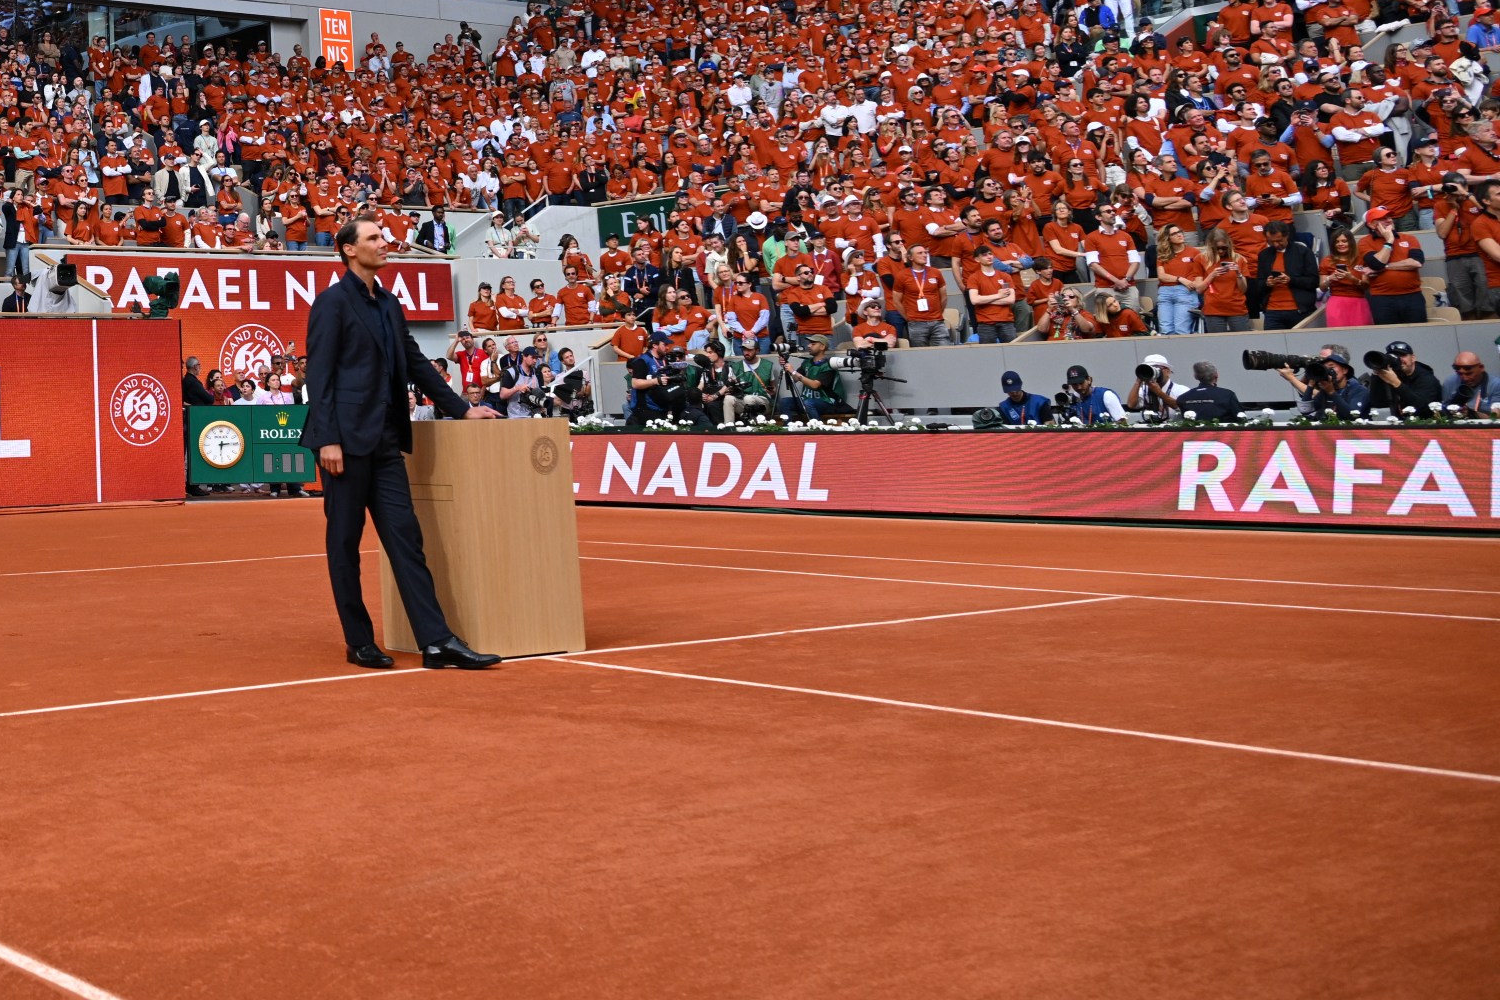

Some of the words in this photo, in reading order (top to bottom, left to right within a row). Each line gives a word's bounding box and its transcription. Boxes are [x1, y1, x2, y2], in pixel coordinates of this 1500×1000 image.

[324, 18, 347, 35] TEN
[327, 45, 349, 63] NIS
[85, 265, 270, 310] RAAEL
[285, 270, 439, 311] NAL
[223, 330, 251, 376] ROLAND
[254, 330, 281, 356] GARR
[113, 378, 139, 418] ROLAND
[141, 378, 167, 417] GARROS
[123, 426, 159, 440] PARIS
[599, 441, 829, 502] NADAL
[1177, 439, 1500, 518] RAFA
